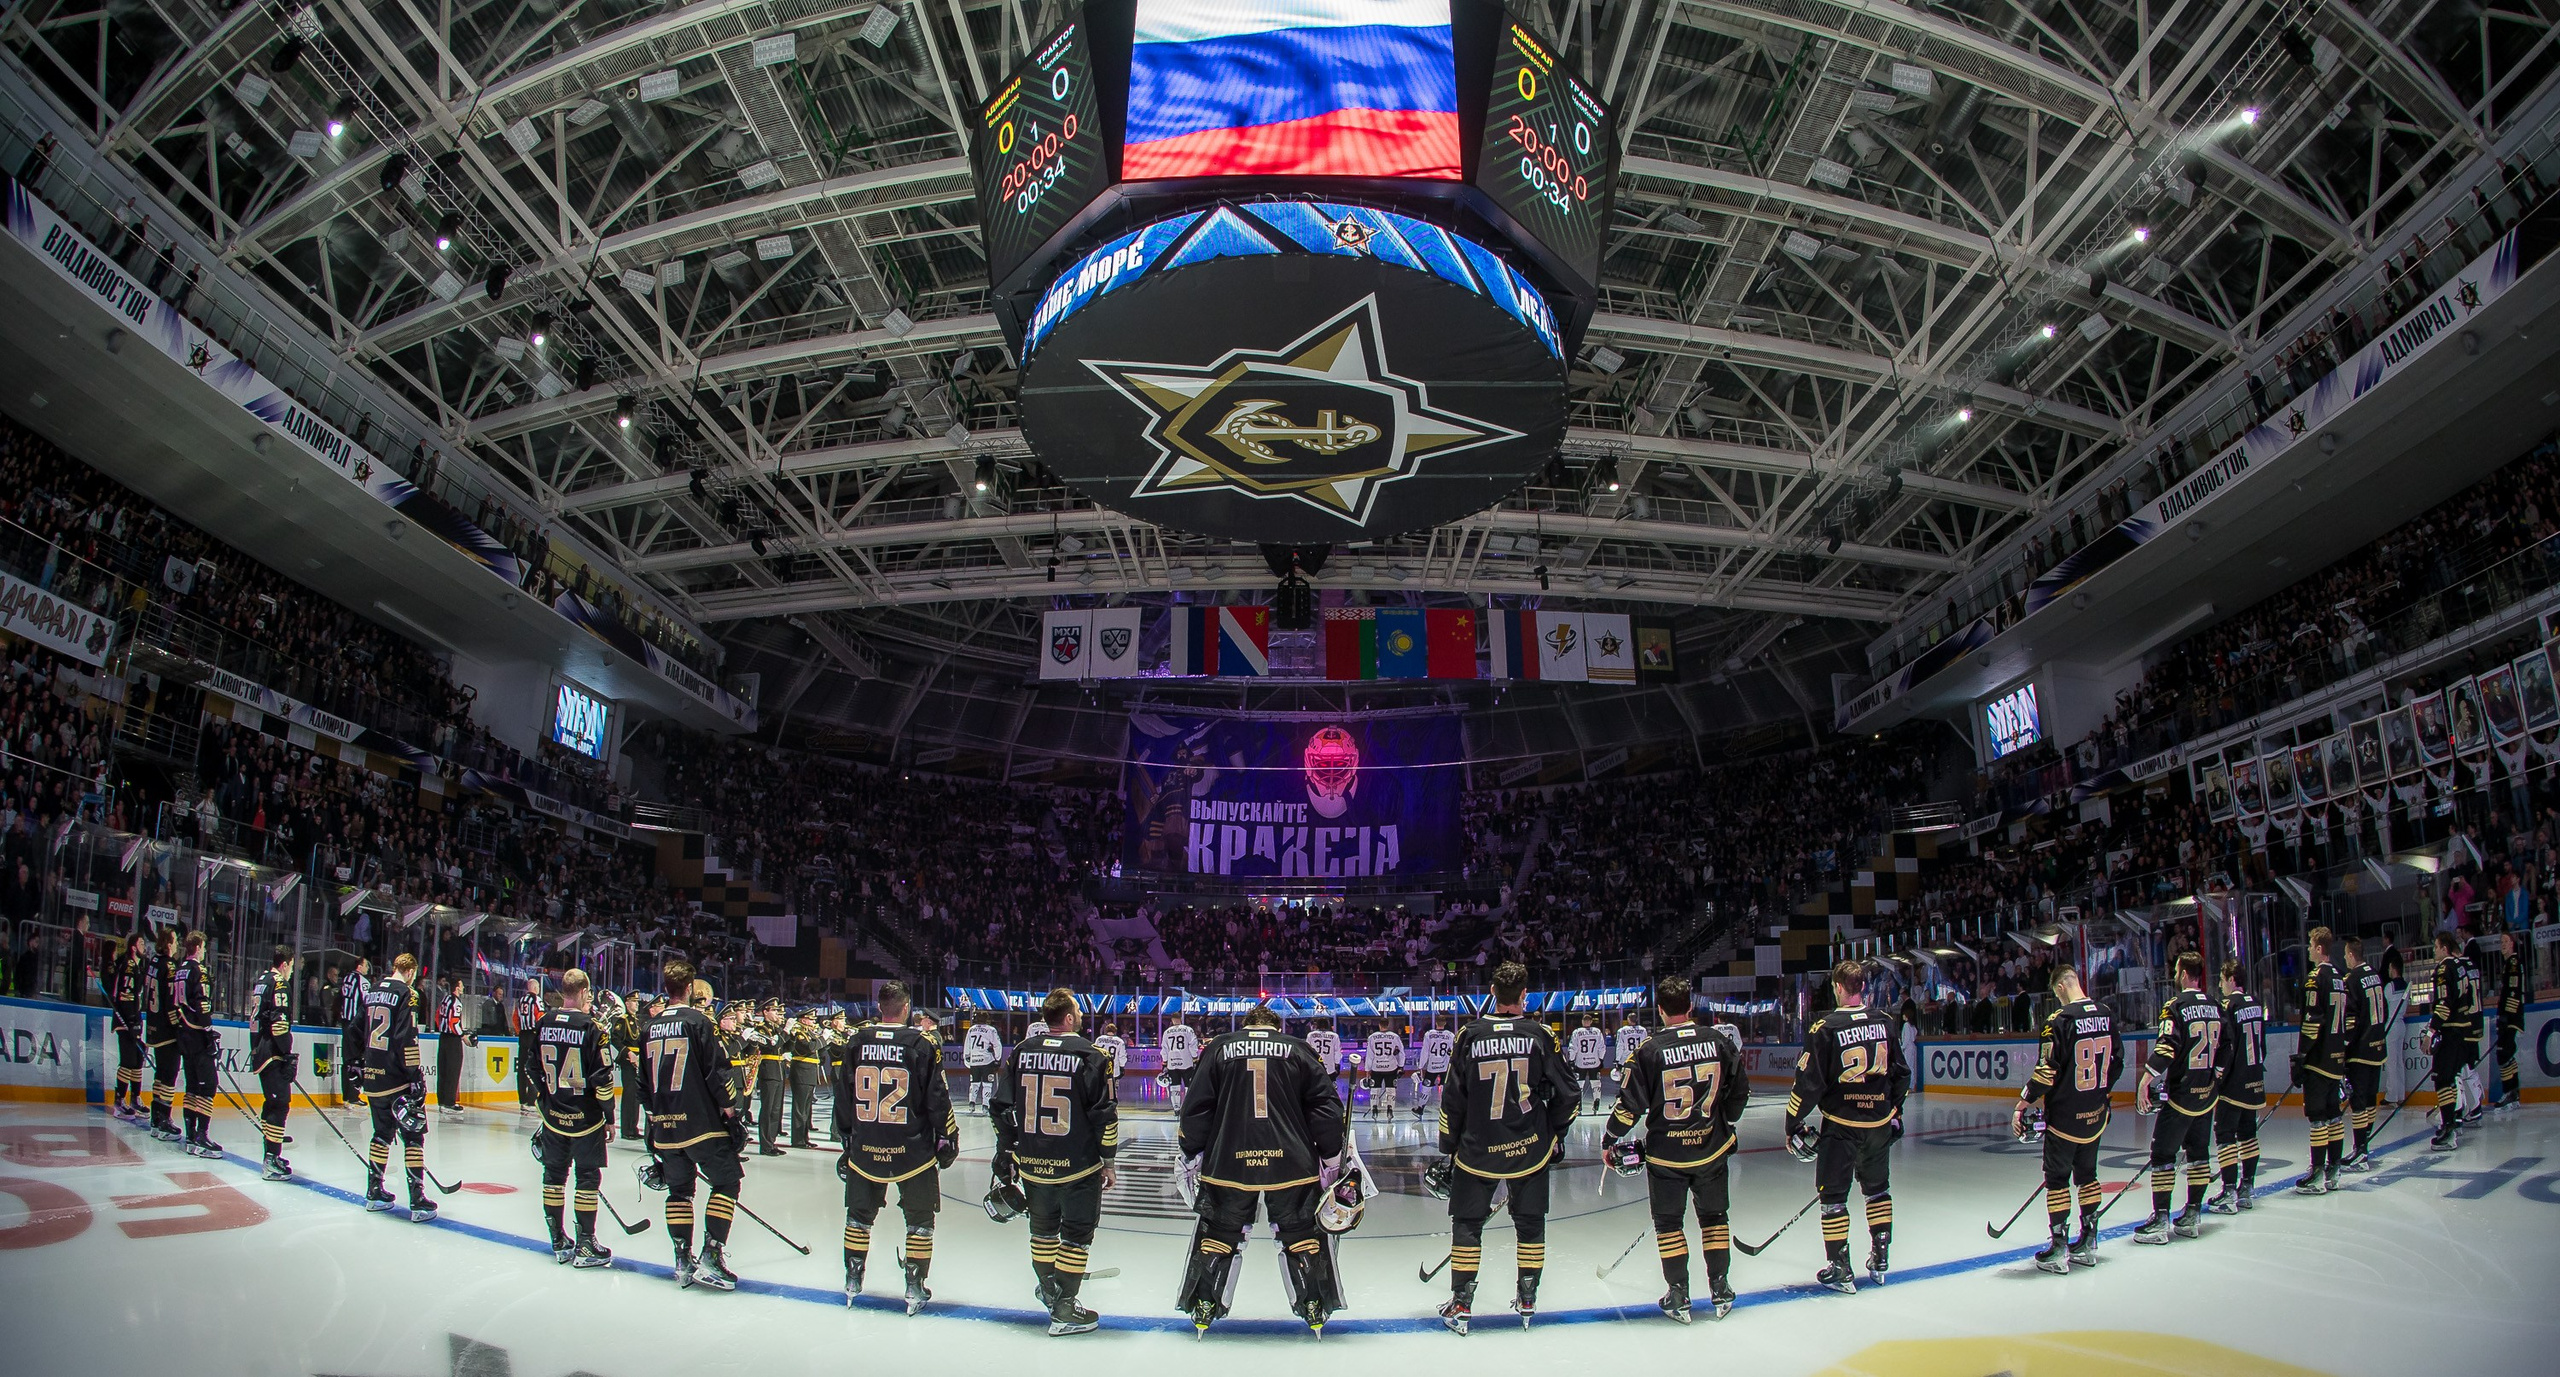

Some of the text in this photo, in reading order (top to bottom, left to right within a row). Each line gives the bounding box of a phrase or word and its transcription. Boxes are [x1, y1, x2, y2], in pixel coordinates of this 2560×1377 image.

[1036, 23, 1075, 66] ТРАКТОР
[1511, 23, 1553, 68] АДМИРАЛ
[1052, 66, 1070, 100] 0
[1518, 67, 1536, 101] 0
[985, 76, 1021, 120] АДМИРАЛ
[1569, 78, 1604, 118] ТРАКТОР
[998, 120, 1014, 155] 0
[1030, 121, 1038, 141] 1
[1549, 123, 1557, 143] 1
[1574, 121, 1590, 155] 0
[1001, 114, 1077, 203] 20:00.0
[1509, 114, 1587, 201] 20:00.0
[1018, 154, 1066, 214] 00:34
[1520, 156, 1570, 216] 00:34
[41, 223, 153, 326] ВЛАДИВОСТОК
[1077, 240, 1145, 297] МОРЕ
[2379, 295, 2456, 368] АДМИРАЛ
[282, 404, 352, 469] АДМИРАЛ
[2158, 446, 2249, 524] ВЛАДИВОСТОК
[1054, 627, 1080, 637] МХЛ
[204, 670, 263, 704] ДИВОСТОК
[665, 659, 715, 704] ВЛАДИВОСТОК
[308, 710, 351, 738] АДМИРАЛ
[2132, 754, 2167, 779] АДМИРАЛ
[1190, 799, 1308, 823] ВЫПУСКАЙТЕ
[108, 901, 134, 913] FONBE
[151, 909, 175, 920] согаз
[274, 993, 288, 1007] 62
[1431, 1001, 1456, 1011] МОРЕ
[2181, 1005, 2220, 1022] SHEVCHENK
[367, 1006, 392, 1051] 12
[540, 1026, 586, 1045] SHESTAKOV
[650, 1021, 683, 1039] GRMAN
[1836, 1023, 1887, 1047] DERYABIN
[861, 1044, 904, 1062] PRINCE
[970, 1034, 985, 1050] 74
[1168, 1035, 1185, 1051] 78
[1223, 1040, 1292, 1060] MISHUROV
[1314, 1039, 1332, 1055] 35
[1374, 1041, 1392, 1057] 55
[1430, 1042, 1447, 1057] 48
[1471, 1037, 1535, 1059] MURANOV
[1580, 1038, 1597, 1053] 87
[1627, 1036, 1641, 1051] 81
[1663, 1041, 1718, 1066] RUCHKIN
[420, 1065, 437, 1076] РАЯ
[540, 1044, 587, 1096] 64
[646, 1037, 689, 1094] 77
[1018, 1052, 1081, 1073] PETUKHOV
[1797, 1051, 1811, 1072] 4
[1838, 1040, 1888, 1084] 24
[1931, 1050, 2009, 1080] согаз
[2074, 1035, 2112, 1092] 87
[1246, 1057, 1269, 1119] 1
[1477, 1057, 1531, 1121] 71
[1620, 1068, 1631, 1089] 7
[855, 1065, 910, 1125] 92
[1661, 1061, 1722, 1121] 57
[1021, 1073, 1072, 1137] 15
[1856, 1100, 1874, 1109] КРАЙ
[1487, 1133, 1539, 1154] ПРИМОРСКИЙ
[1667, 1125, 1713, 1138] ПРИМОРСКИЙ
[1681, 1137, 1702, 1146] КРАЙ
[862, 1144, 906, 1154] ПРИМОРСКИЙ
[873, 1153, 892, 1162] КРАЙ
[1505, 1148, 1527, 1158] КРАЙ
[1020, 1156, 1071, 1168] ПРИМОРСКИЙ
[1033, 1166, 1055, 1175] КРАЙ
[1246, 1157, 1269, 1167] КРАЙ
